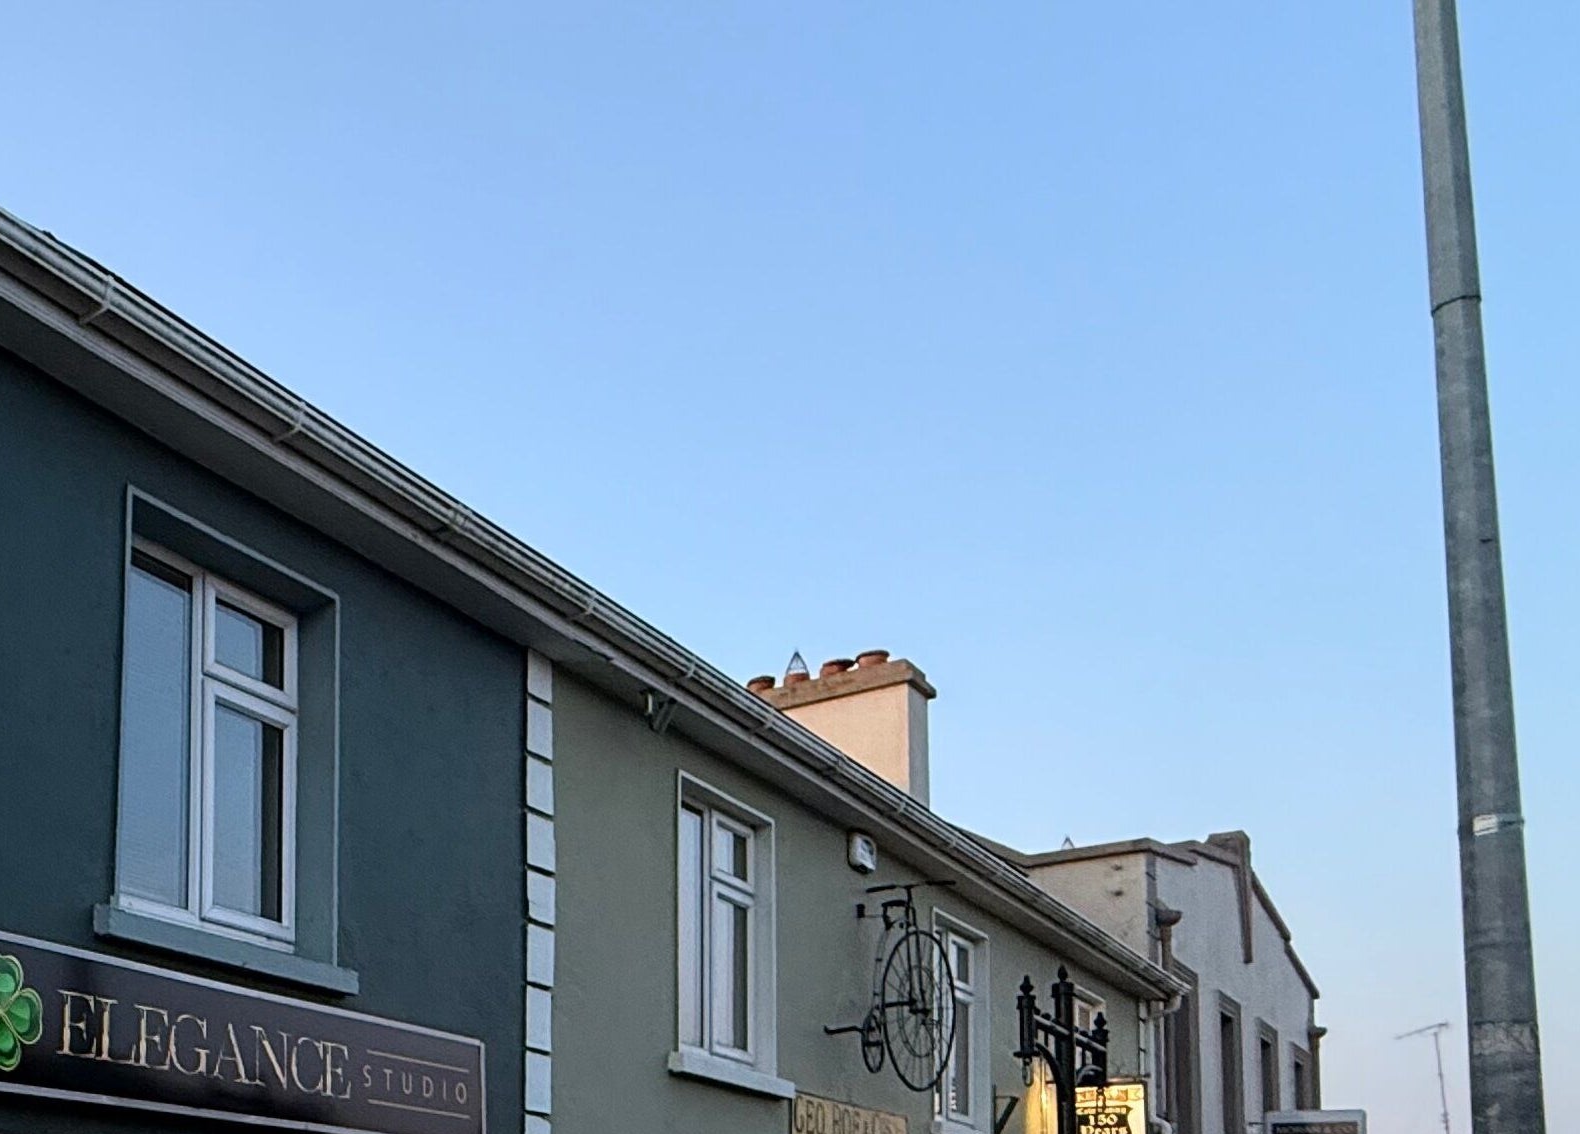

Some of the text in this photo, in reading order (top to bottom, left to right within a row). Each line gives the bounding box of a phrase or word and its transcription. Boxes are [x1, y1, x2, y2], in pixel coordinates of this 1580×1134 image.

[56, 989, 468, 1104] ELEGANCE STUDIO
[1088, 1114, 1118, 1126] 150
